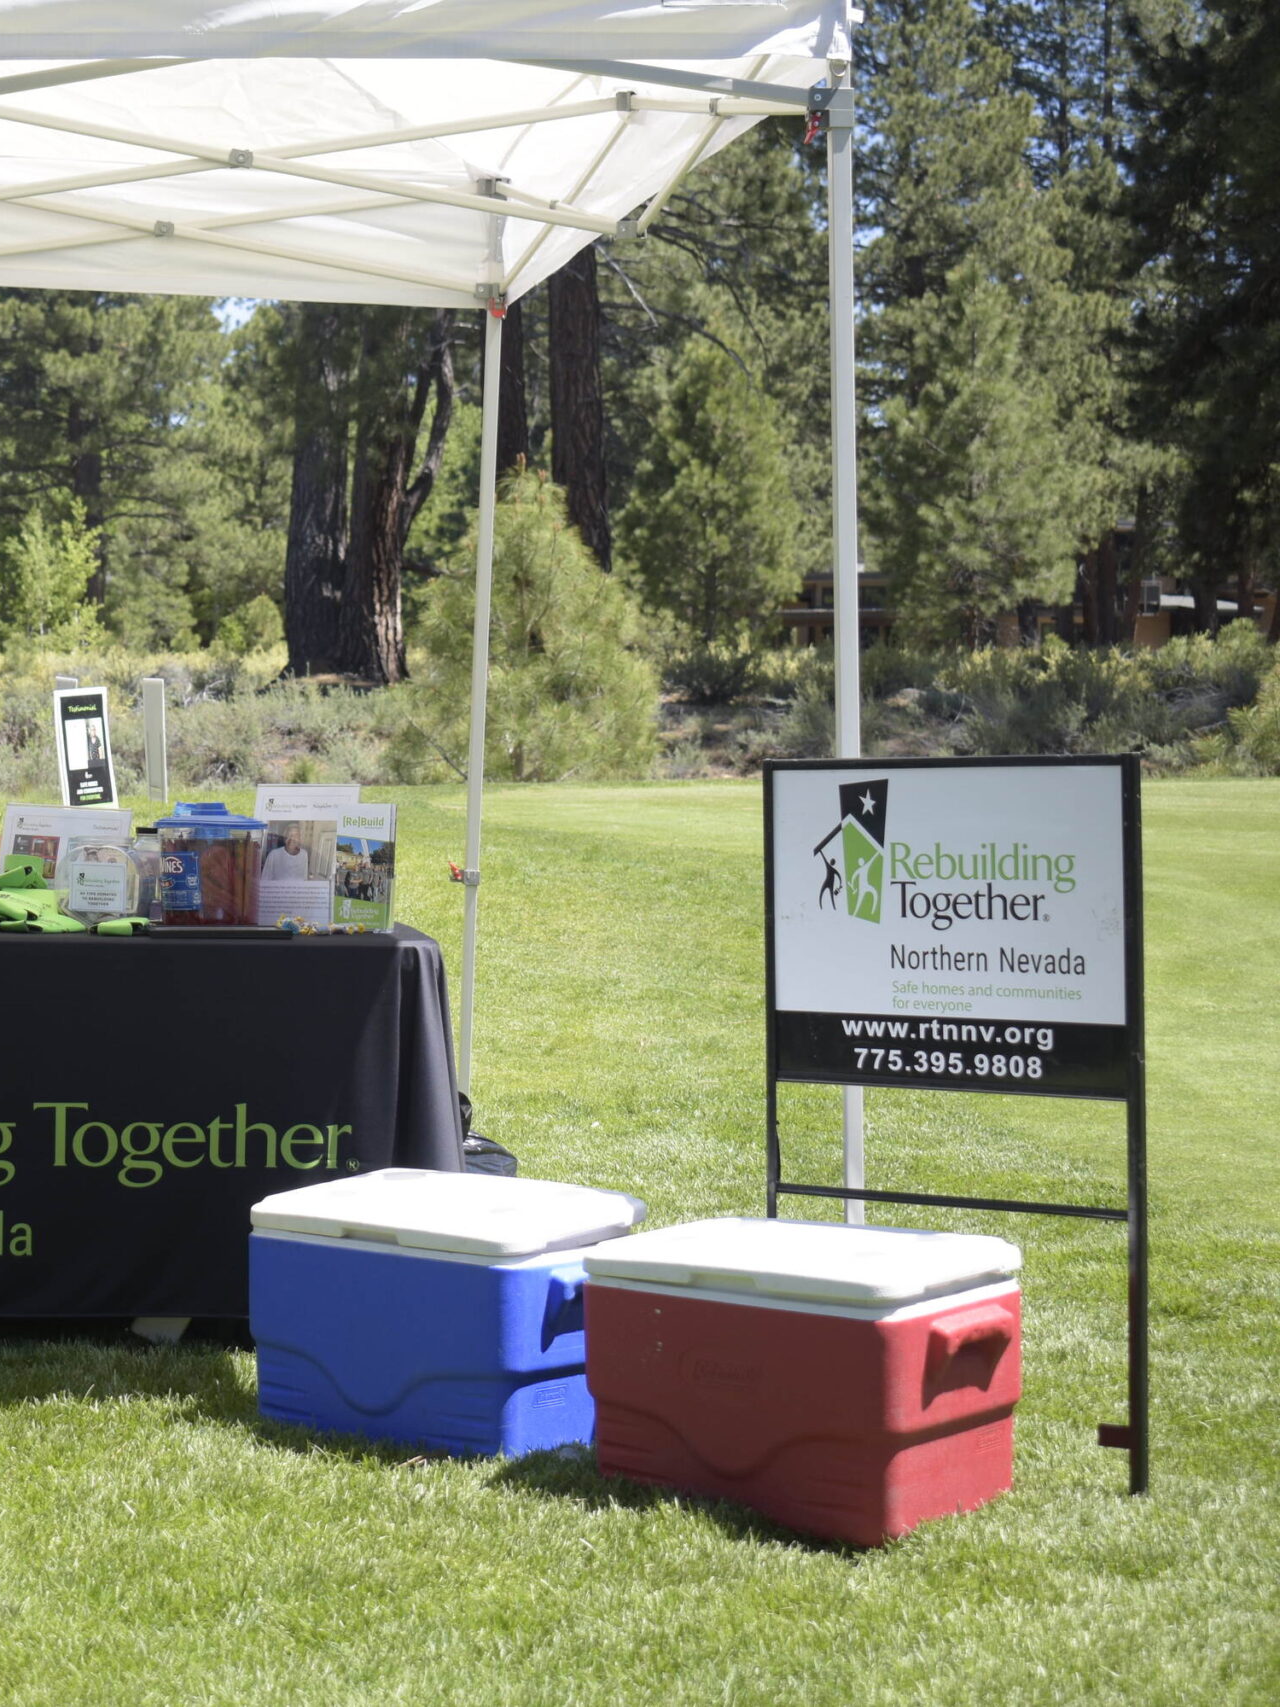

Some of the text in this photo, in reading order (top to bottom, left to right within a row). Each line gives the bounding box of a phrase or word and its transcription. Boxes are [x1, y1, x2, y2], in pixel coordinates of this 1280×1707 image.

[889, 841, 1076, 894] Rebuilding
[890, 943, 1086, 976] Northern Nevada
[891, 980, 1083, 1001] Safe homes and communities
[892, 997, 973, 1013] for everyone
[841, 1017, 1055, 1051] www.rtnnv.org
[853, 1047, 1045, 1080] 775.395.9808
